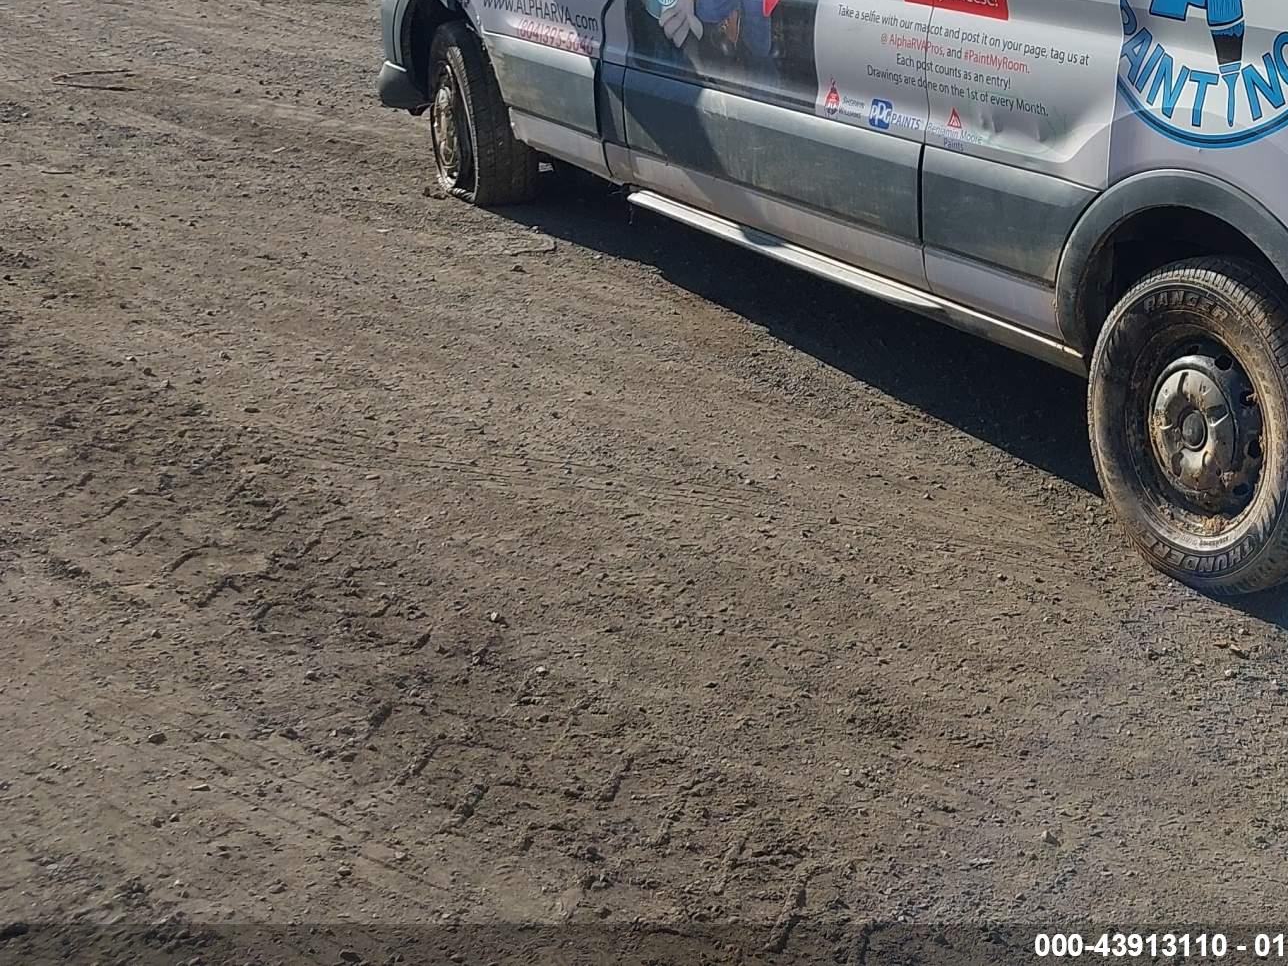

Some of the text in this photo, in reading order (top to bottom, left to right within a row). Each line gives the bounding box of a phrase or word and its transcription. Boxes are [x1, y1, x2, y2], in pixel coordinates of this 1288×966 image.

[838, 4, 1090, 66] Take a selfie with our mascot and post it on your page, tag us at
[881, 33, 887, 45] @
[947, 46, 962, 60] and
[964, 51, 1031, 74] #PaintMyRoom.
[896, 53, 1011, 90] Each post counts as an entry!
[867, 64, 1049, 117] Drawings are done on the 1st of every Month.
[870, 102, 921, 130] PPG PAINTS
[944, 137, 963, 151] Paints
[1143, 290, 1229, 321] RANGER
